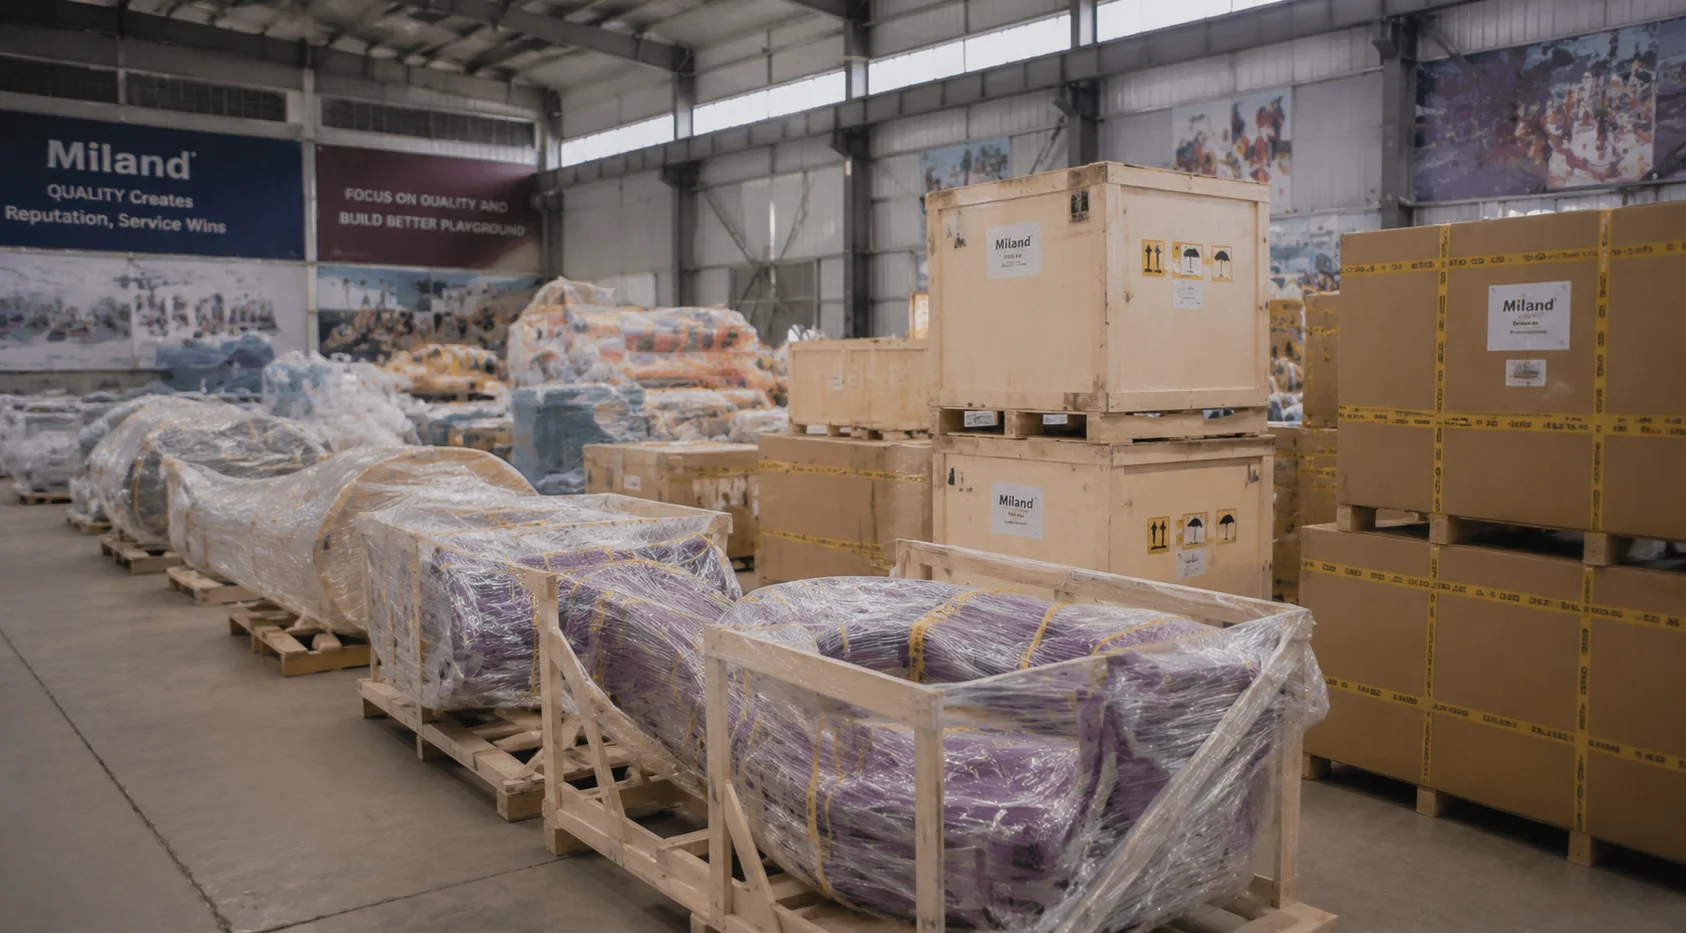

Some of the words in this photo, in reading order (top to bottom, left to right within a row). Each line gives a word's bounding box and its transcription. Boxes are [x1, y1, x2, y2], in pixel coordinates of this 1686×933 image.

[47, 139, 191, 180] Miland
[47, 183, 125, 202] QUALITY
[129, 189, 194, 209] Creates
[344, 188, 393, 204] FOCUS
[395, 192, 417, 206] ON
[480, 200, 509, 214] AND
[4, 204, 115, 229] Reputation,
[117, 213, 183, 232] Service
[185, 217, 228, 235] Wins
[339, 211, 383, 227] BUILD
[386, 214, 438, 231] BETTER
[440, 219, 526, 237] PLAYGROUND
[995, 236, 1031, 250] Miland
[1503, 298, 1554, 312] Miland
[999, 494, 1034, 509] Miland
